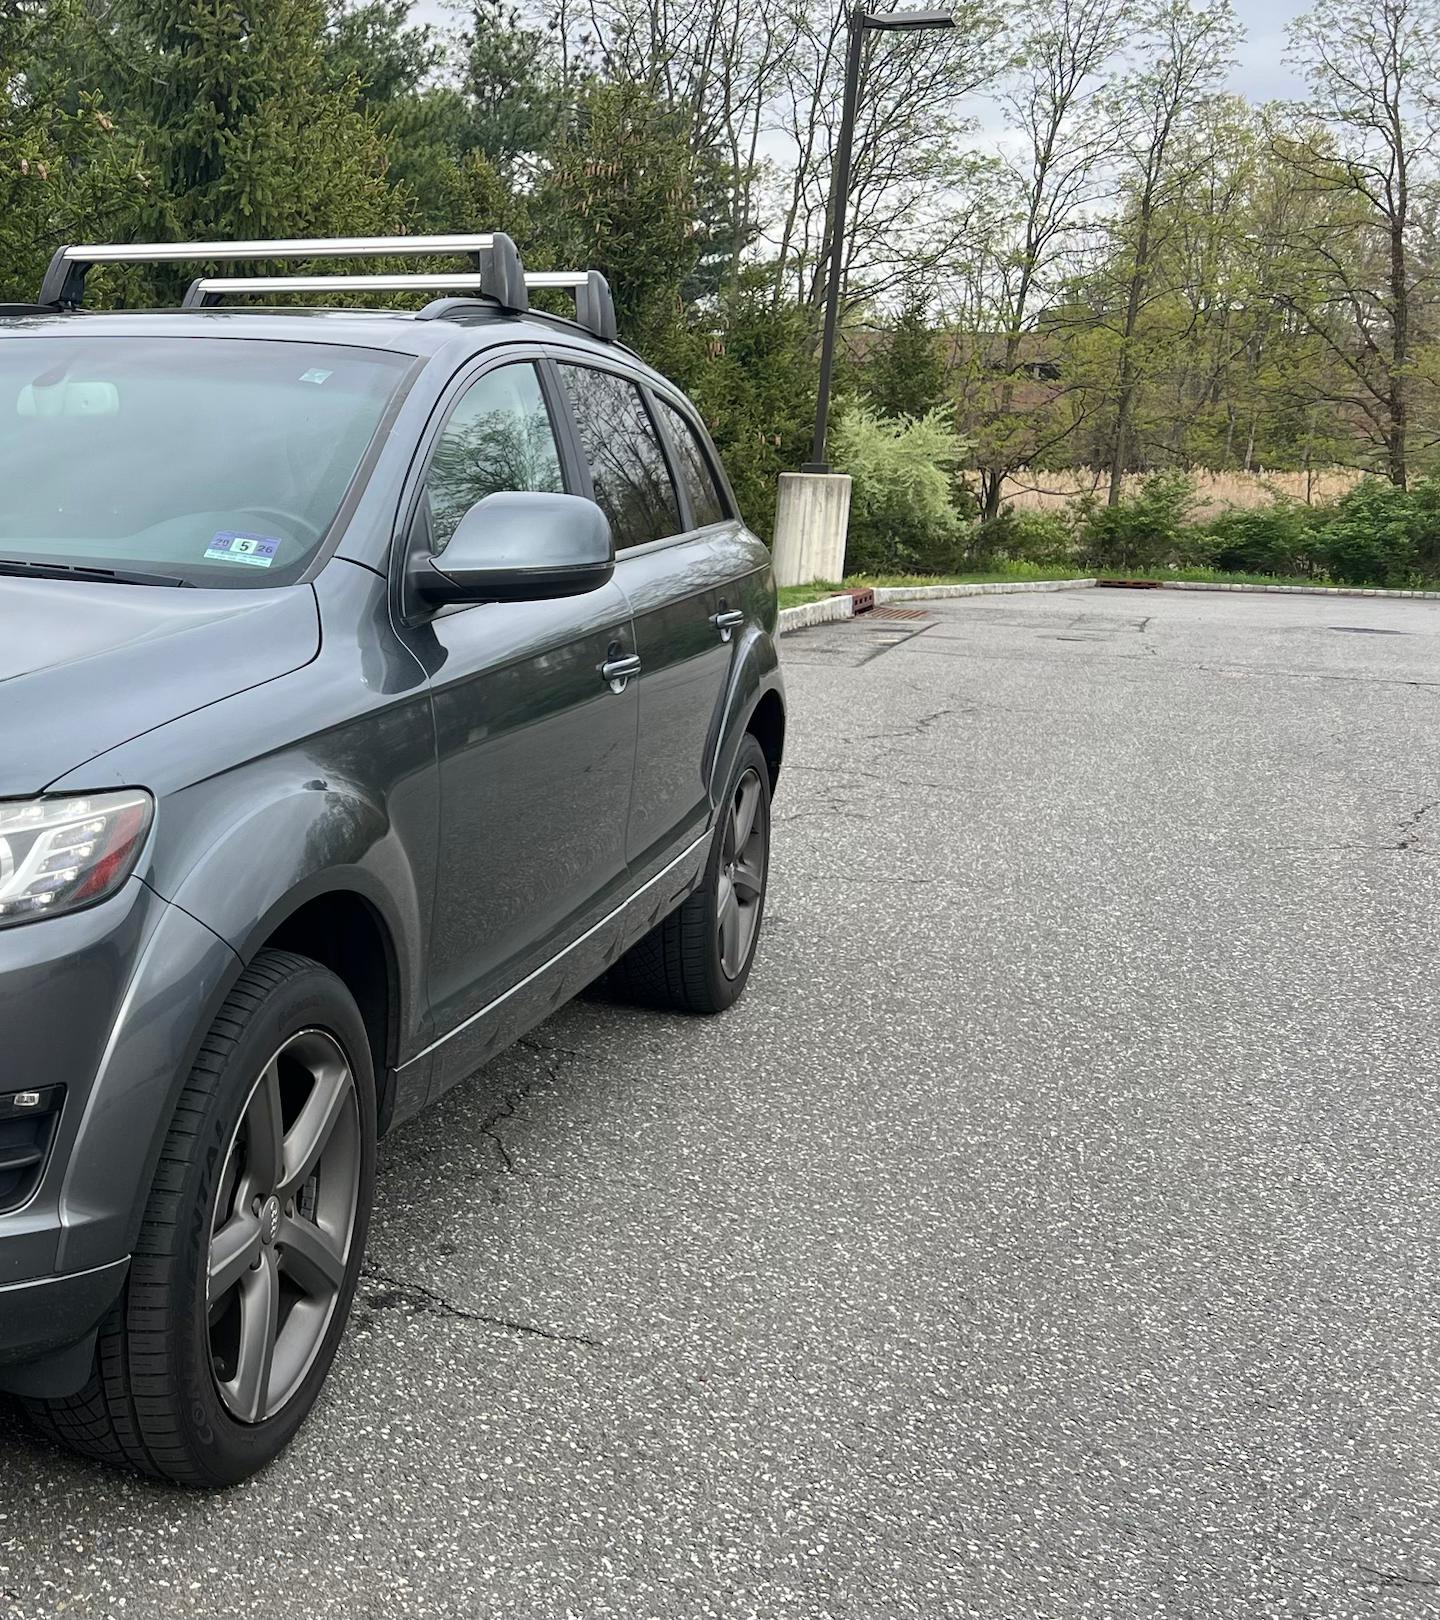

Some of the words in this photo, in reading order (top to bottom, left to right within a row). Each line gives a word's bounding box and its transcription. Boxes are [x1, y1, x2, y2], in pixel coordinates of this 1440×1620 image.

[239, 540, 250, 552] 5
[257, 544, 273, 554] 26
[182, 1118, 227, 1446] CONENTAL
